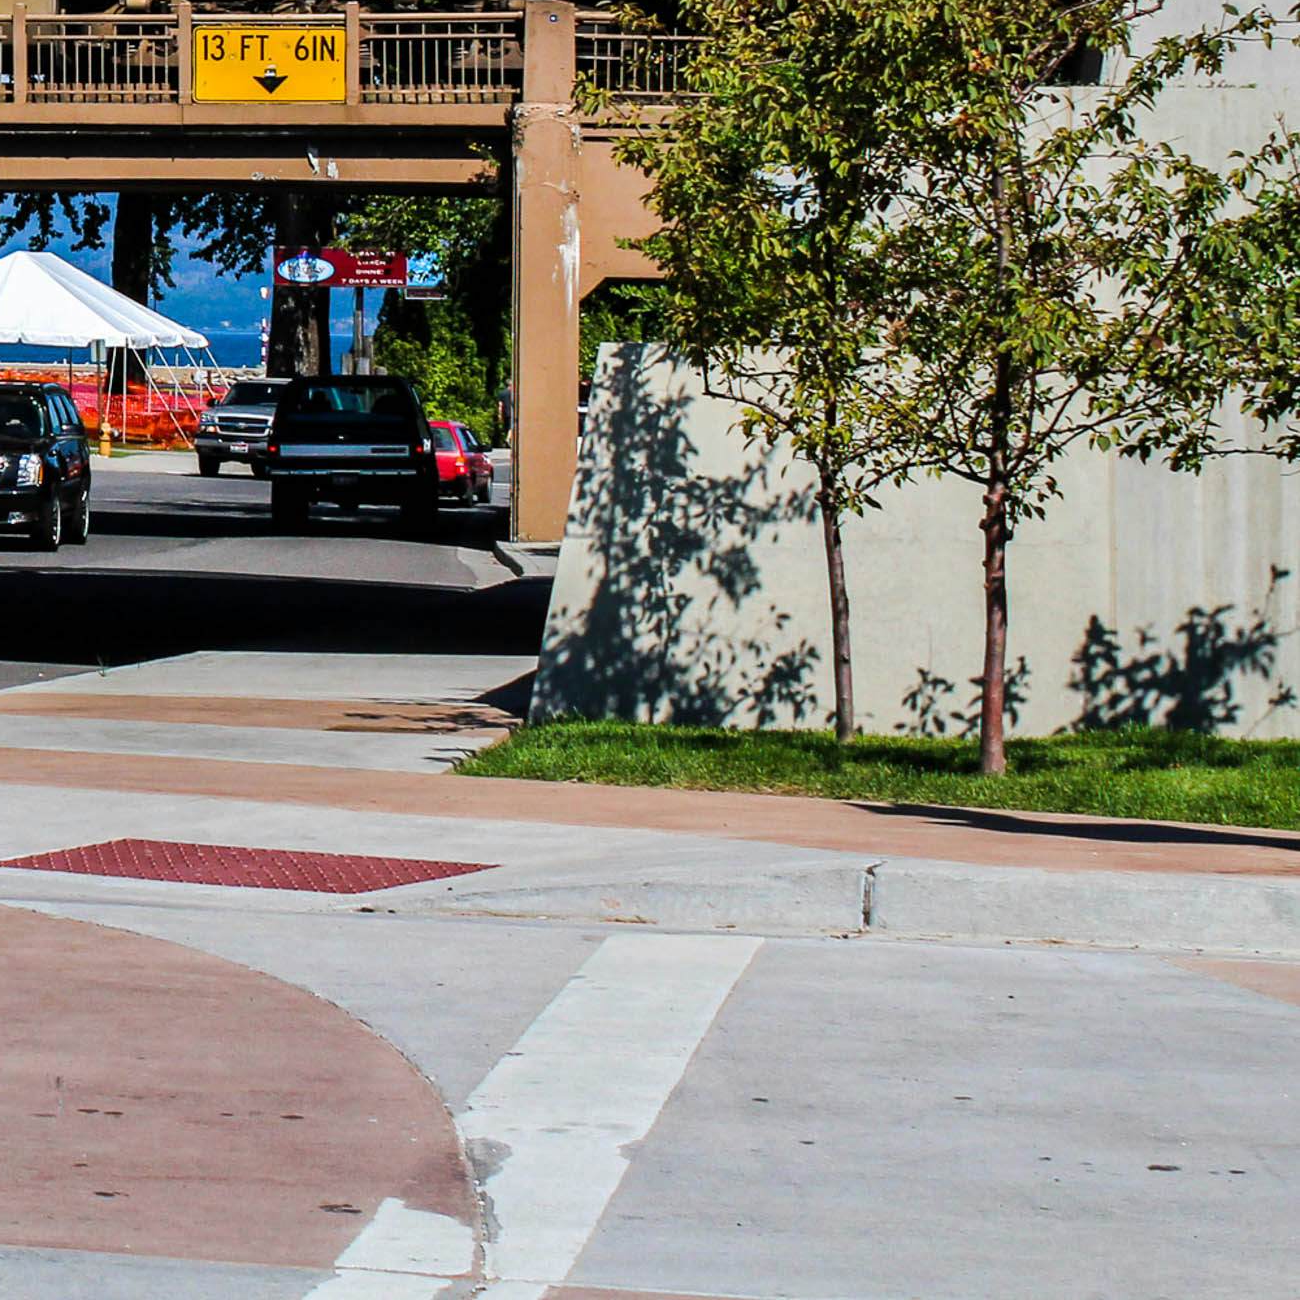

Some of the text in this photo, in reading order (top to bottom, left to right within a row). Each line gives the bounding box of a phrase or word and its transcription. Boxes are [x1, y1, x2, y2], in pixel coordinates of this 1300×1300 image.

[202, 35, 340, 63] 13 FT. 6IN.
